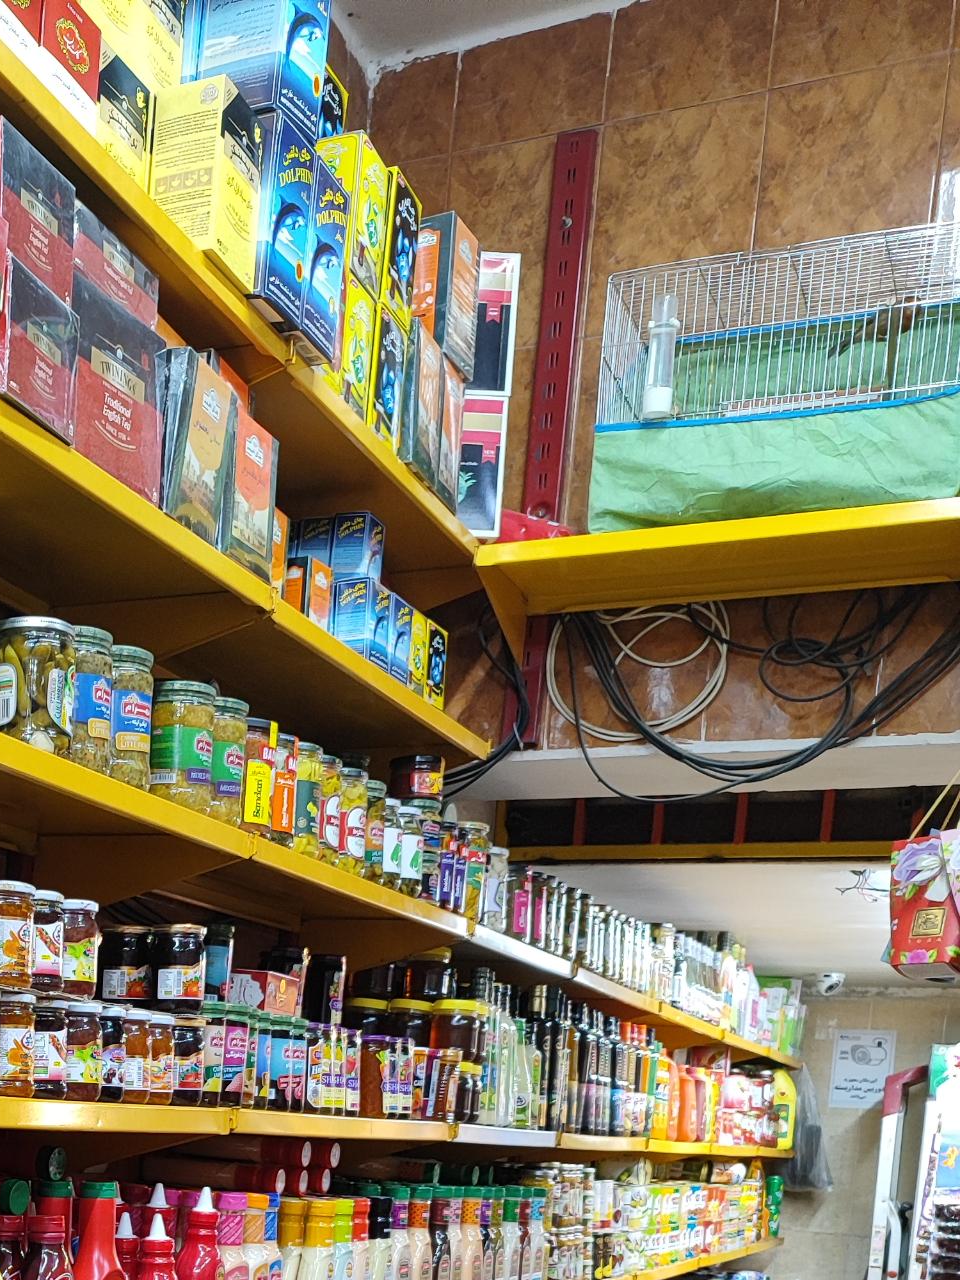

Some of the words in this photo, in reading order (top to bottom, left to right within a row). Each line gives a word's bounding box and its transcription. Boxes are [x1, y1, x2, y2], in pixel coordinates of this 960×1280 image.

[279, 167, 313, 188] DOLPHIN
[317, 211, 347, 228] DOLPHIN
[100, 360, 138, 395] TWININGS
[104, 392, 132, 418] Traditional
[102, 405, 121, 425] English
[121, 418, 131, 432] Tea
